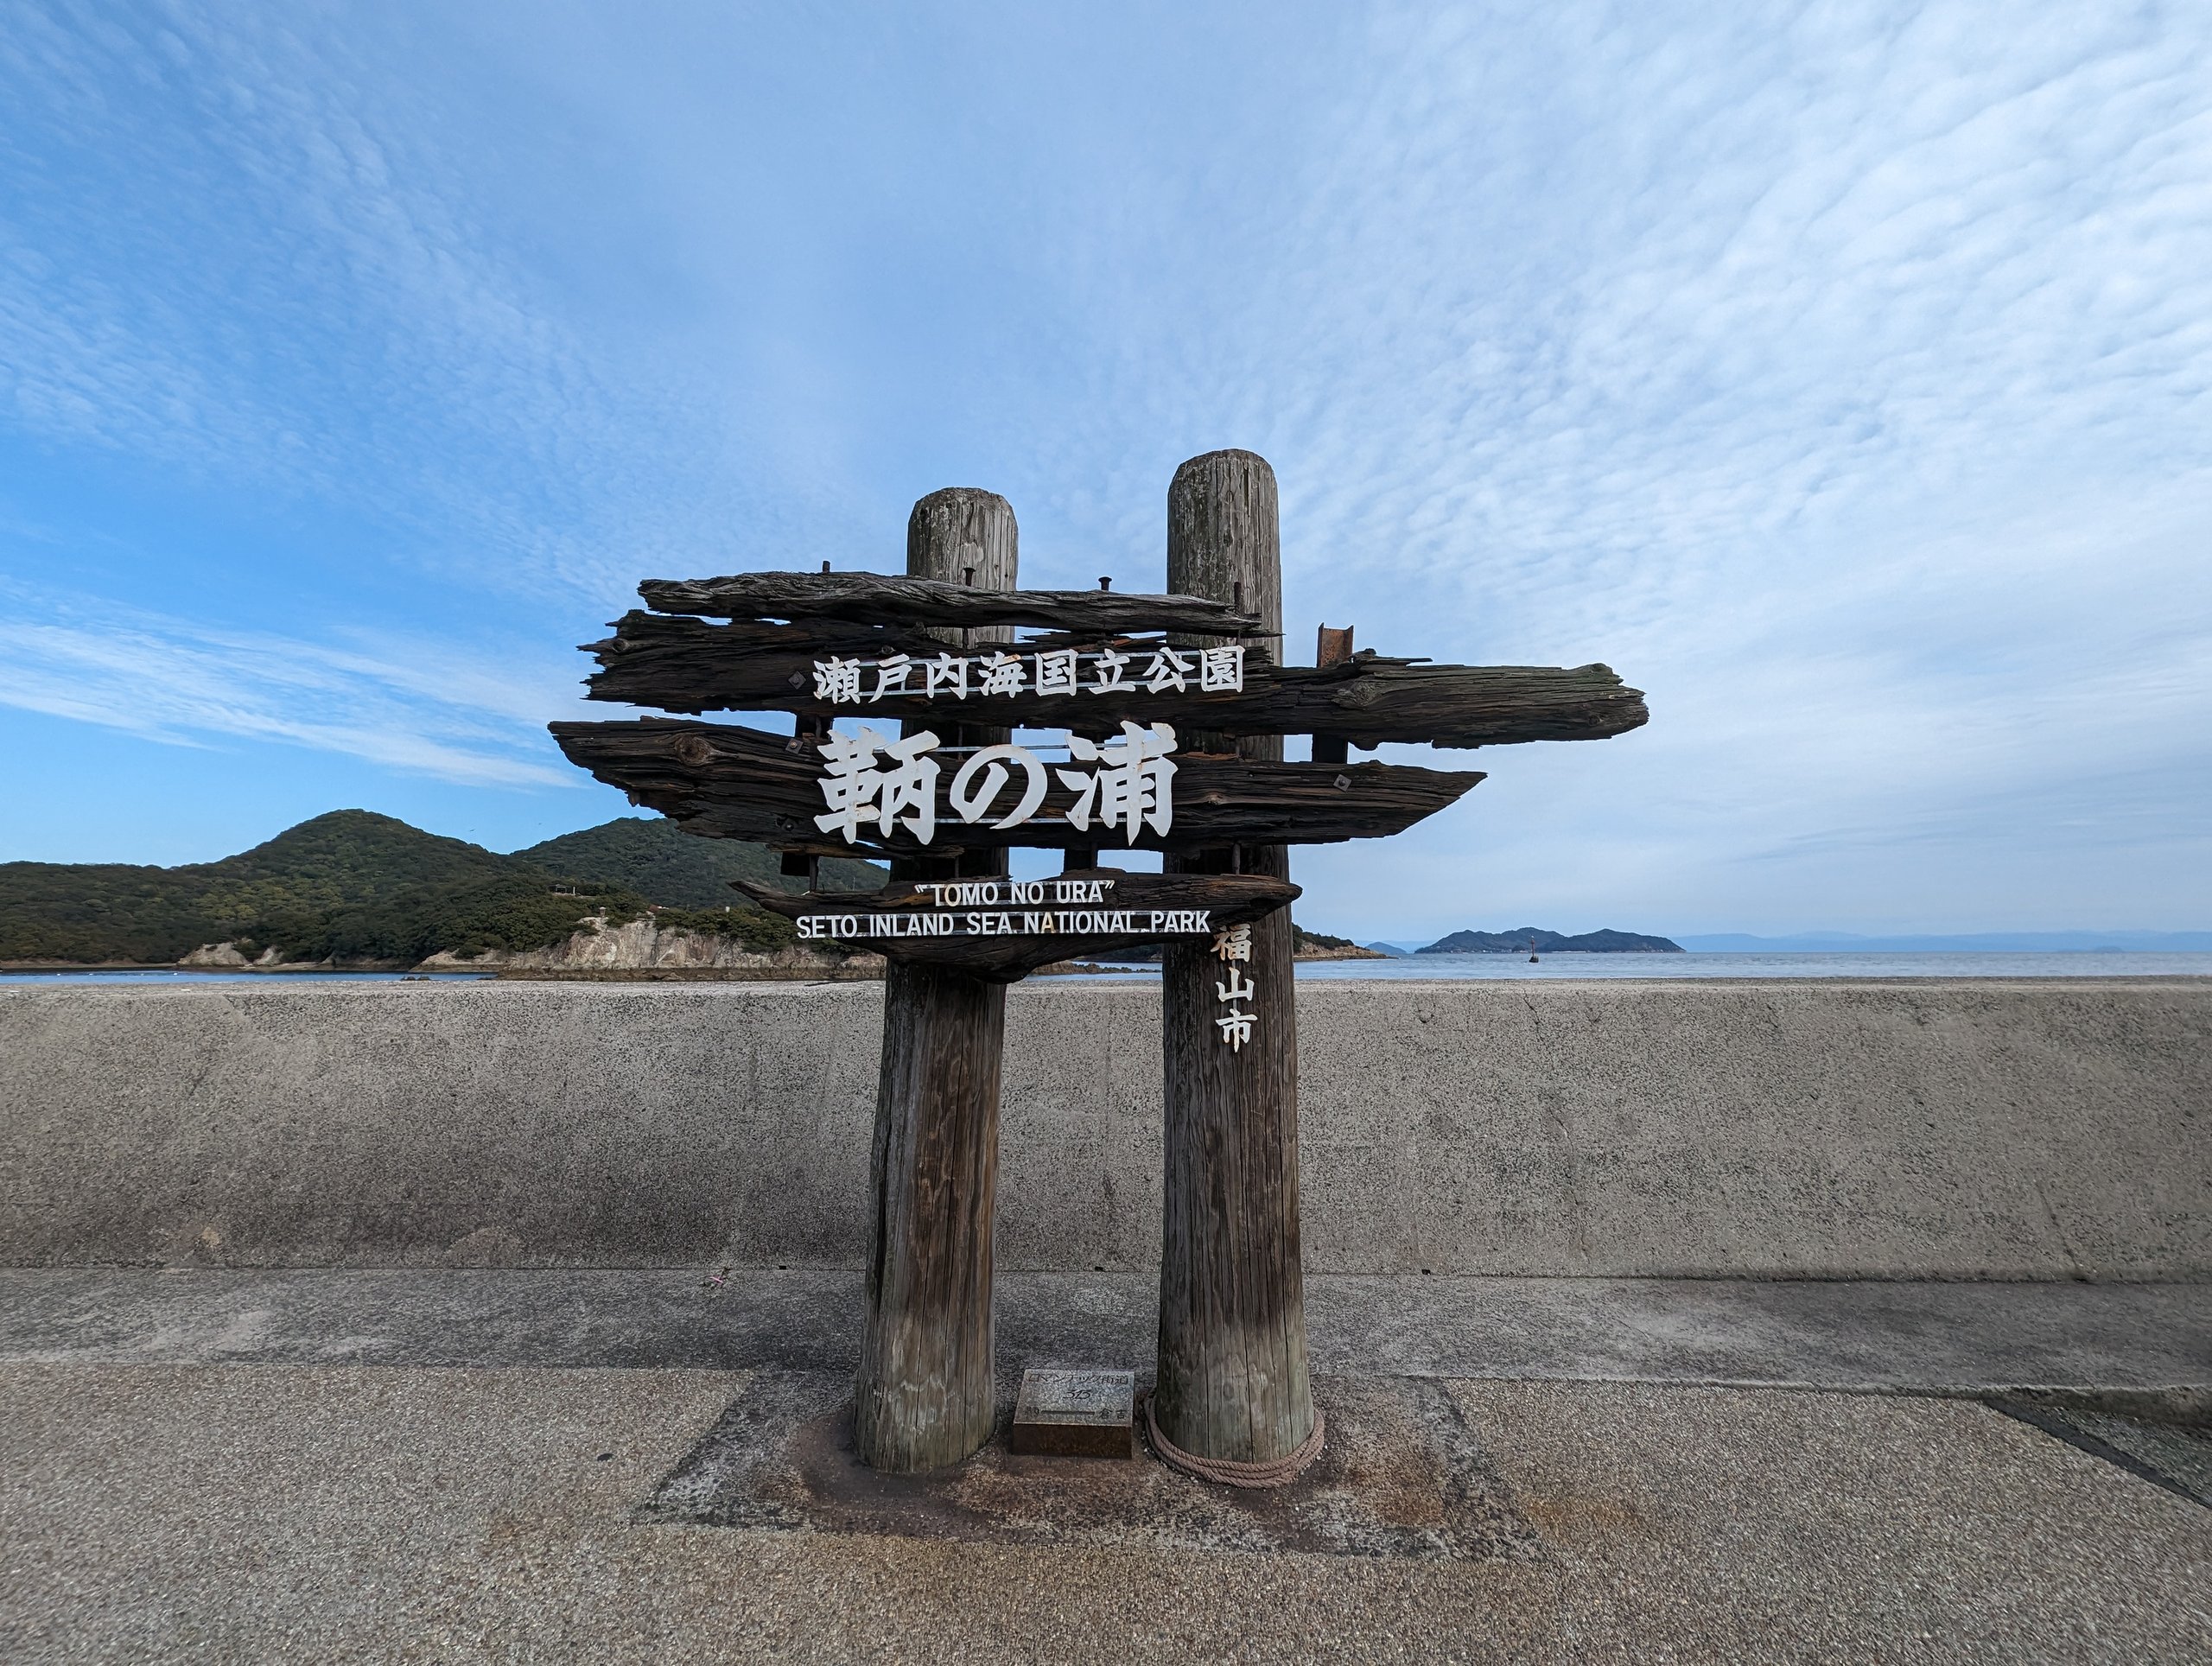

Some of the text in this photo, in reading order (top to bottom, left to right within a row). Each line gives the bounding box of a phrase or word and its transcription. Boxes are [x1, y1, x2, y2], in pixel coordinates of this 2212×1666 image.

[813, 645, 1245, 704] 瀬戸内海国立公園
[813, 720, 1179, 846] 鞆の浦
[1011, 881, 1045, 905] NO
[796, 910, 1211, 939] SETO INLAND SEA NATIONAL PARK
[1211, 923, 1258, 1053] 福山市
